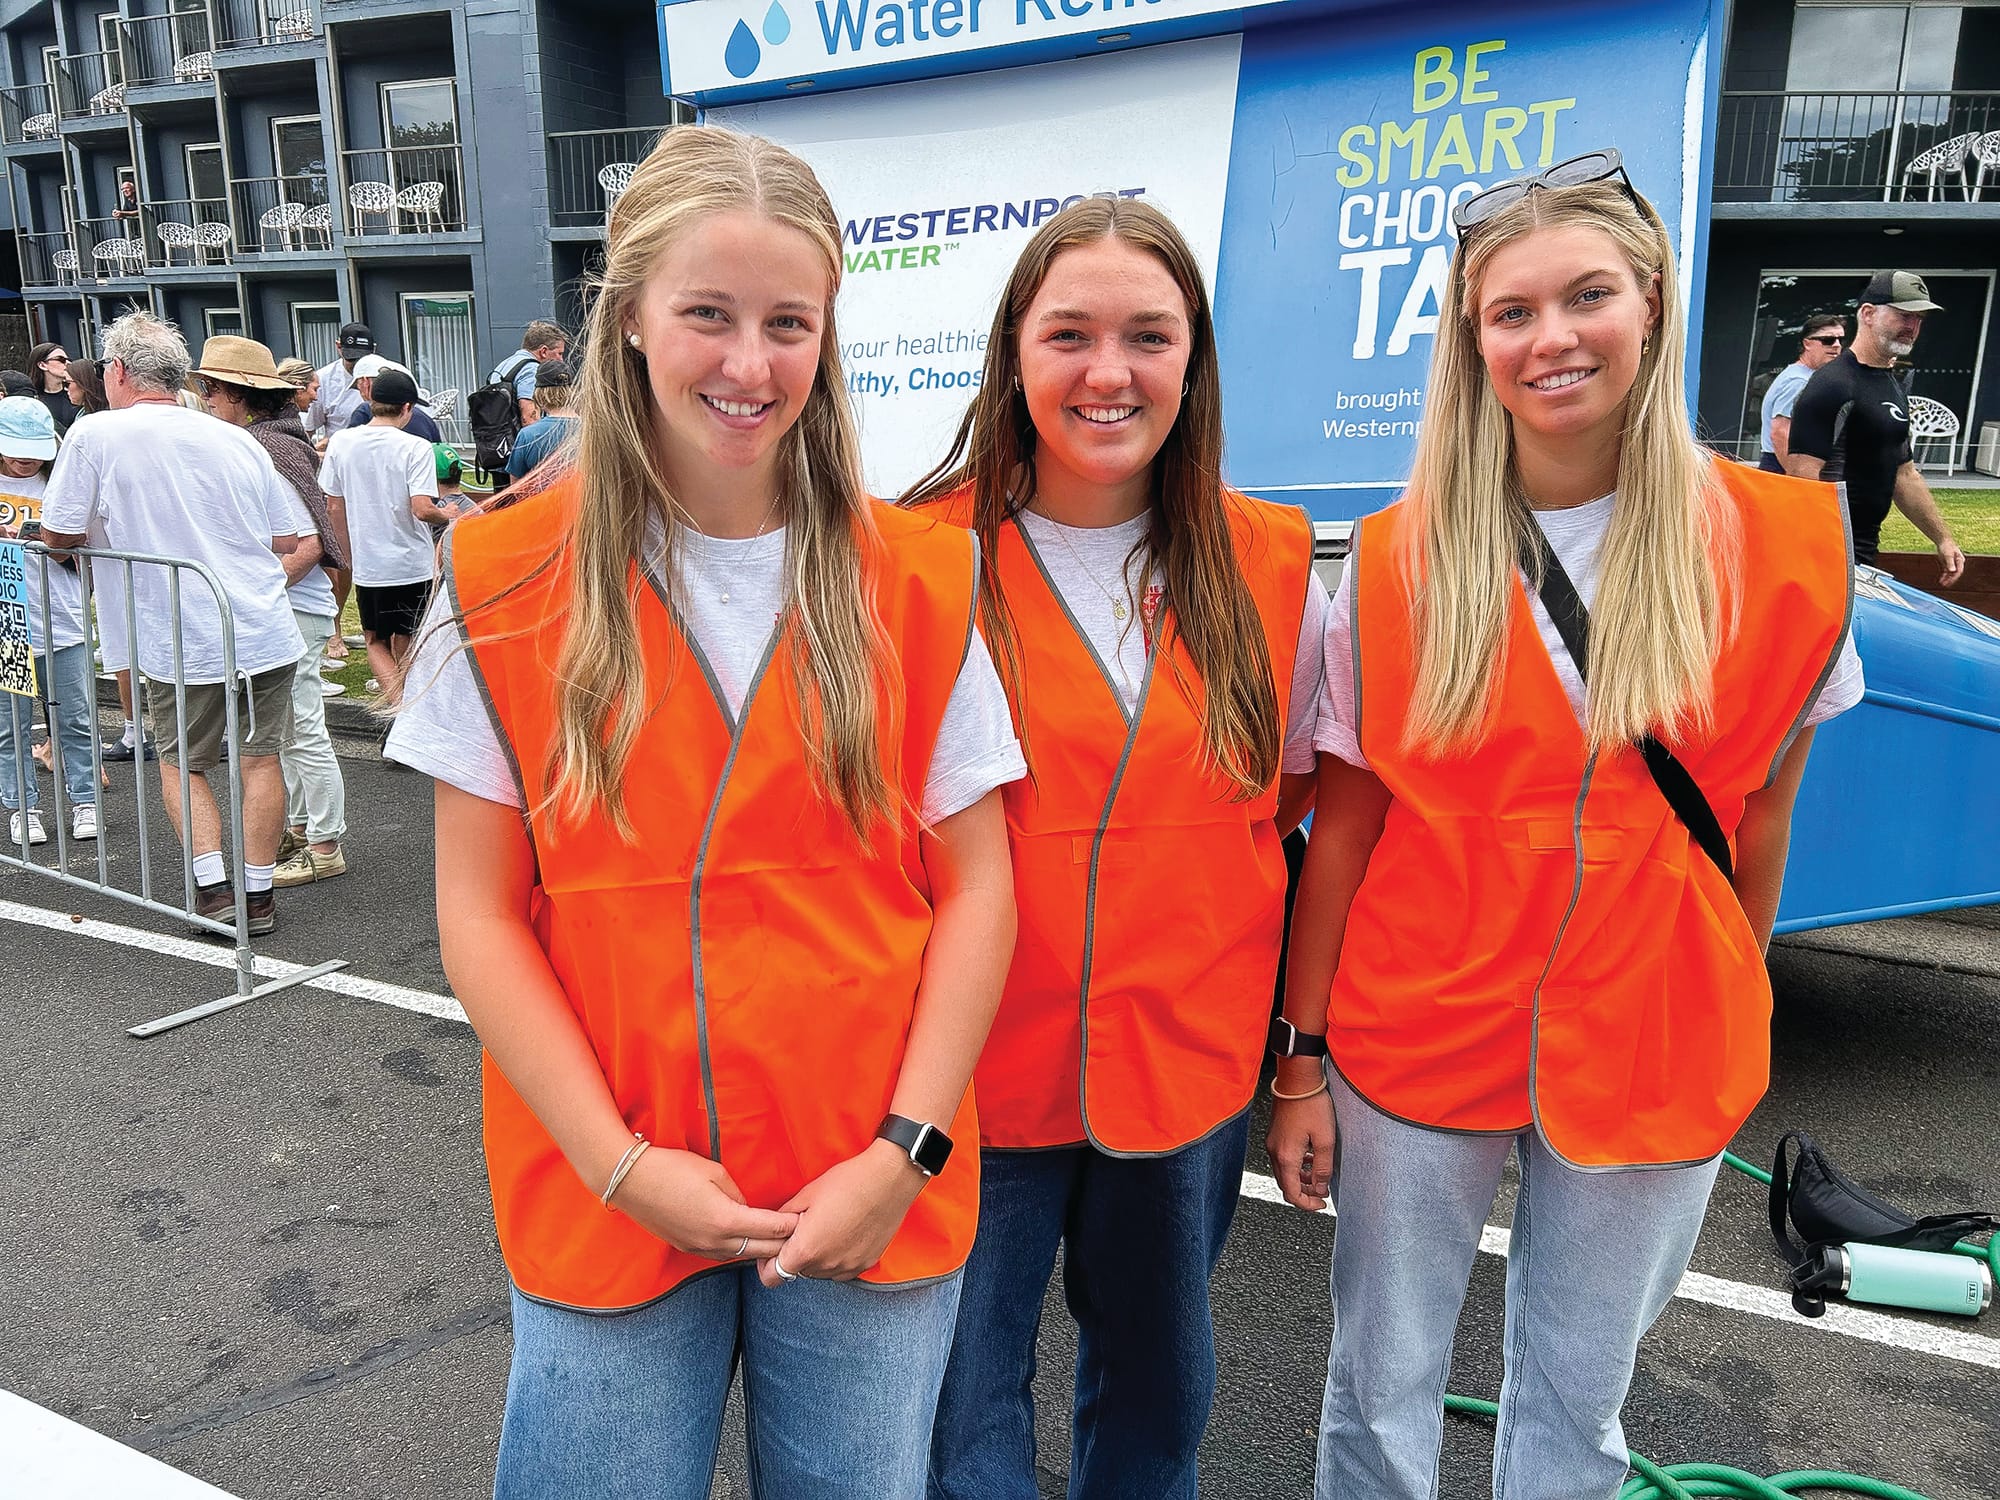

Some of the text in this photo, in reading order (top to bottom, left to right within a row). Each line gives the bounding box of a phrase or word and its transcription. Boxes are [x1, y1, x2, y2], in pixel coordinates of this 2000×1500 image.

[815, 0, 982, 55] Water
[1412, 39, 1506, 113] BE
[1335, 97, 1577, 188] SMART
[842, 187, 1145, 246] WESTERNPT
[1338, 180, 1511, 249] CHOO
[841, 341, 890, 364] your
[1336, 388, 1421, 412] brought
[0, 564, 23, 582] ESS
[0, 582, 17, 600] IO
